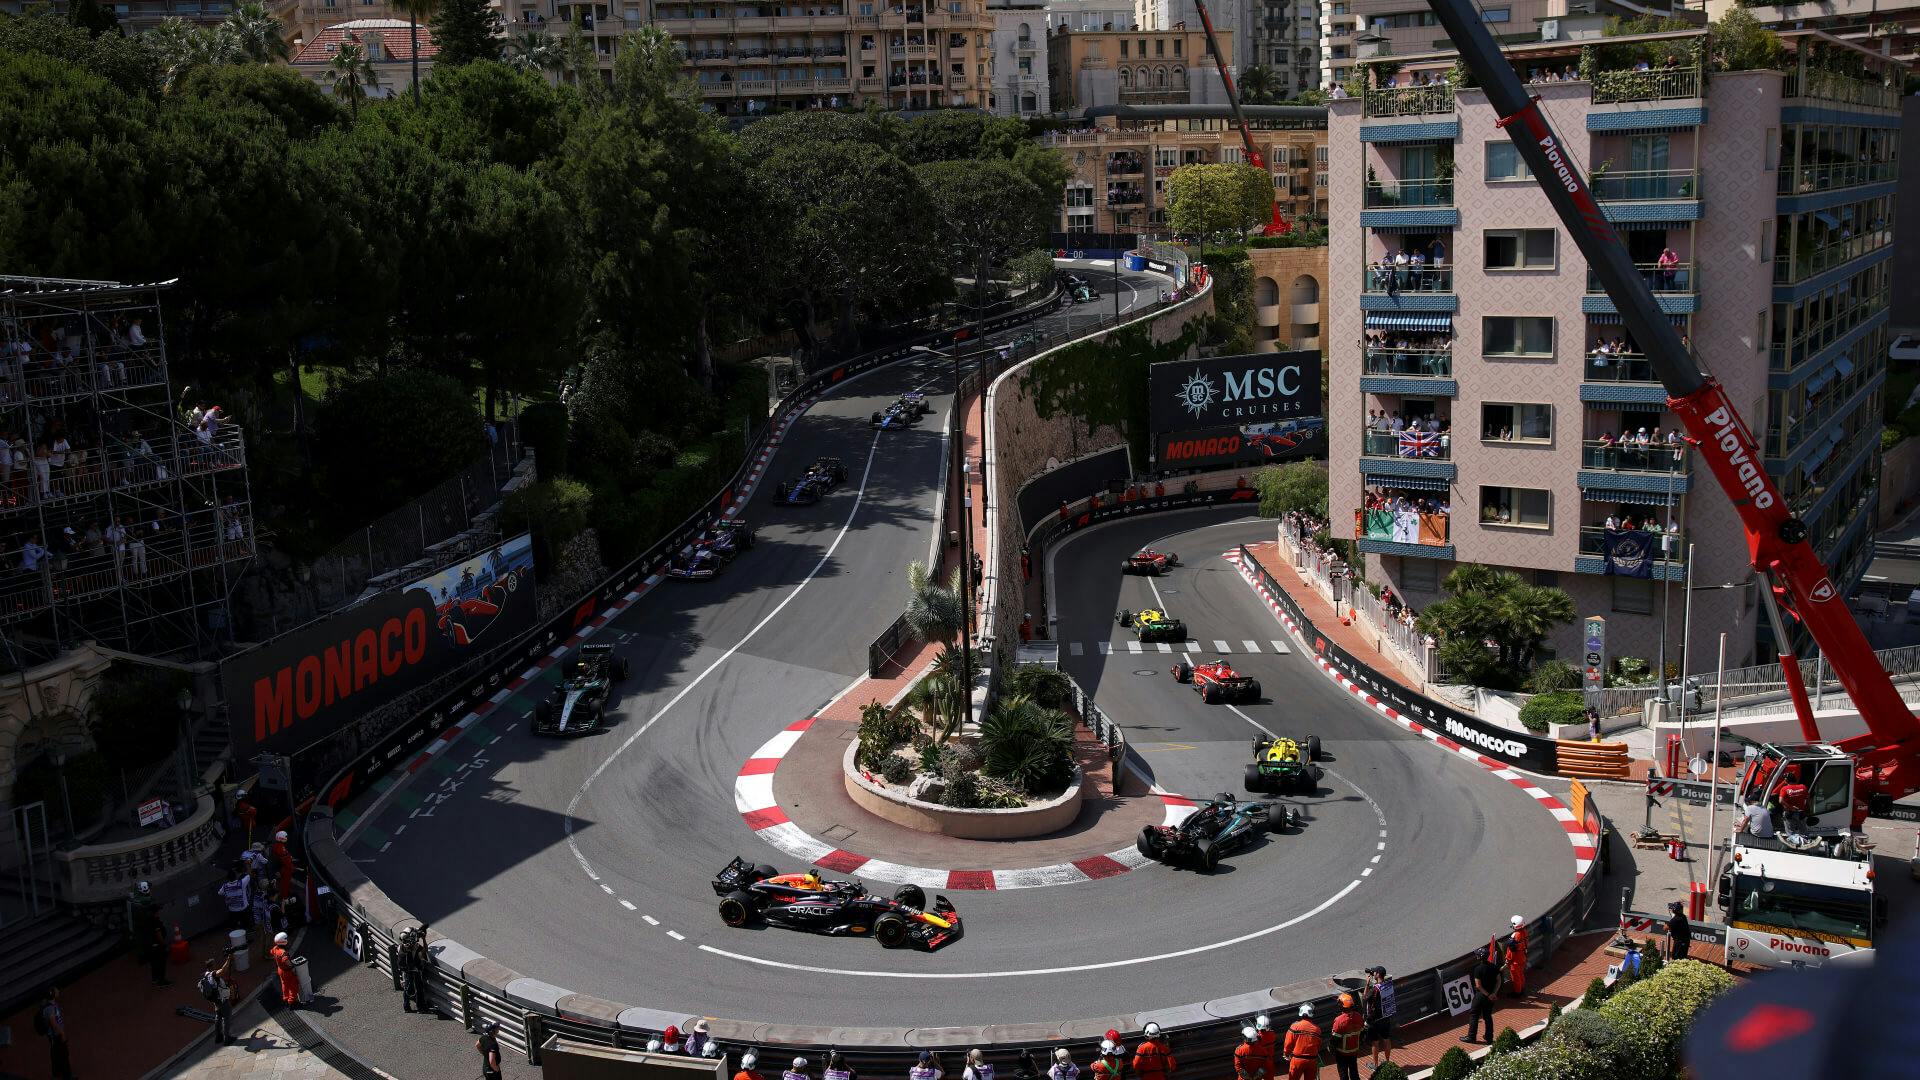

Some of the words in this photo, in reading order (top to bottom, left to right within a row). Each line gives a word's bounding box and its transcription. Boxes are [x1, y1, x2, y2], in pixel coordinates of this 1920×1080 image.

[1538, 135, 1579, 194] Piovano
[1222, 365, 1301, 402] MSC
[1222, 401, 1302, 418] CRUISES
[1166, 435, 1241, 461] MONACO
[1703, 406, 1775, 510] Piovano
[253, 607, 427, 743] MONACO
[1445, 716, 1528, 759] #MonacoGP
[1681, 788, 1723, 801] Piovao
[788, 905, 835, 916] ORACLE
[1770, 938, 1830, 957] Piovano
[1449, 981, 1472, 1009] SC
